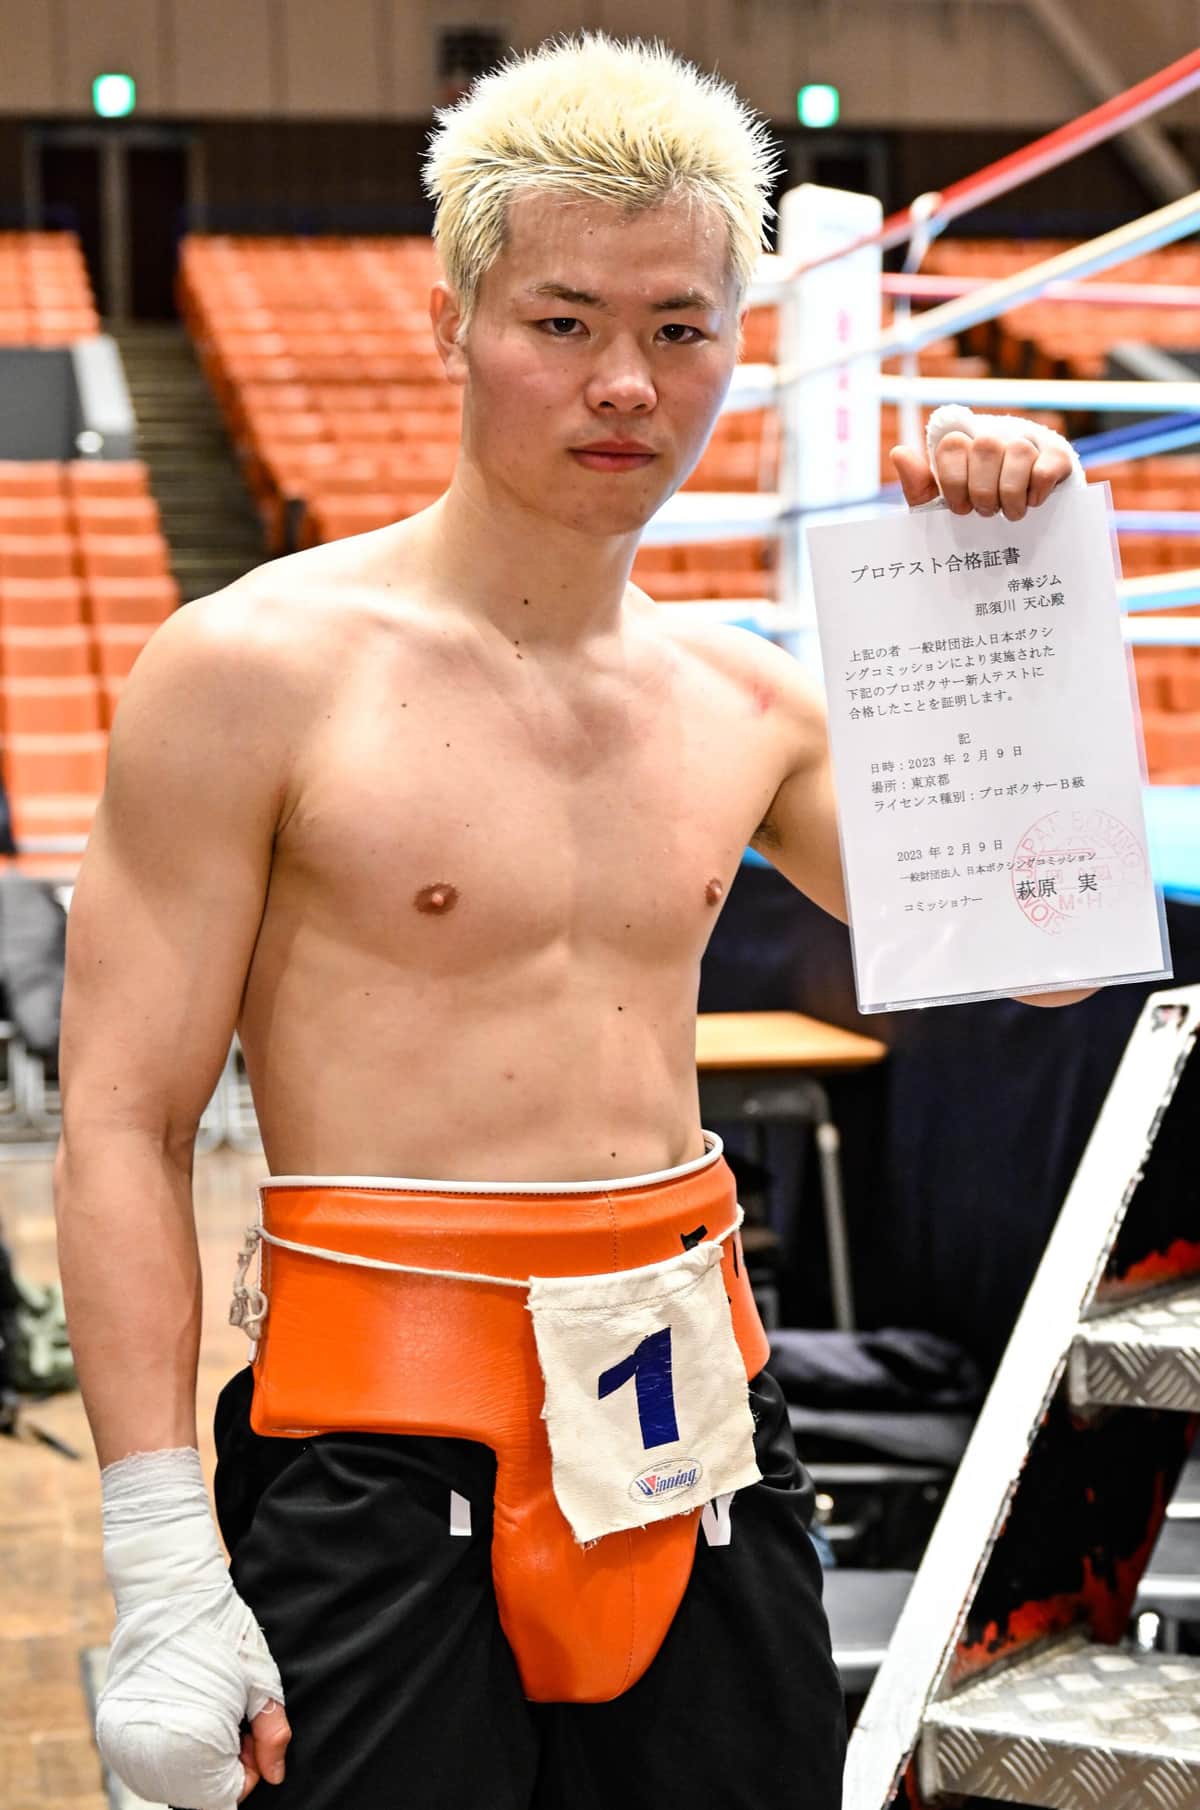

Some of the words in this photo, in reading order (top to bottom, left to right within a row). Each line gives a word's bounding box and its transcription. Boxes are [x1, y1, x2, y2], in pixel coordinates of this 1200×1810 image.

[851, 547, 1021, 583] プロテスト合格証書
[1007, 574, 1063, 592] 帝拳ジム
[975, 599, 1017, 617] 那須川
[1023, 592, 1065, 611] 天心殿
[845, 645, 1056, 681] ングコミッションにより実施された
[850, 645, 901, 662] 上記の者
[848, 666, 1045, 701] 下記のプロボクサー新人テストに
[849, 689, 1014, 721] 合格したことを証明します。
[958, 733, 971, 745] 記
[1016, 878, 1058, 901] 萩原
[1078, 873, 1098, 893] 実
[904, 896, 984, 912] コミッショナー
[598, 1325, 680, 1450] 1
[635, 1468, 697, 1496] Winning
